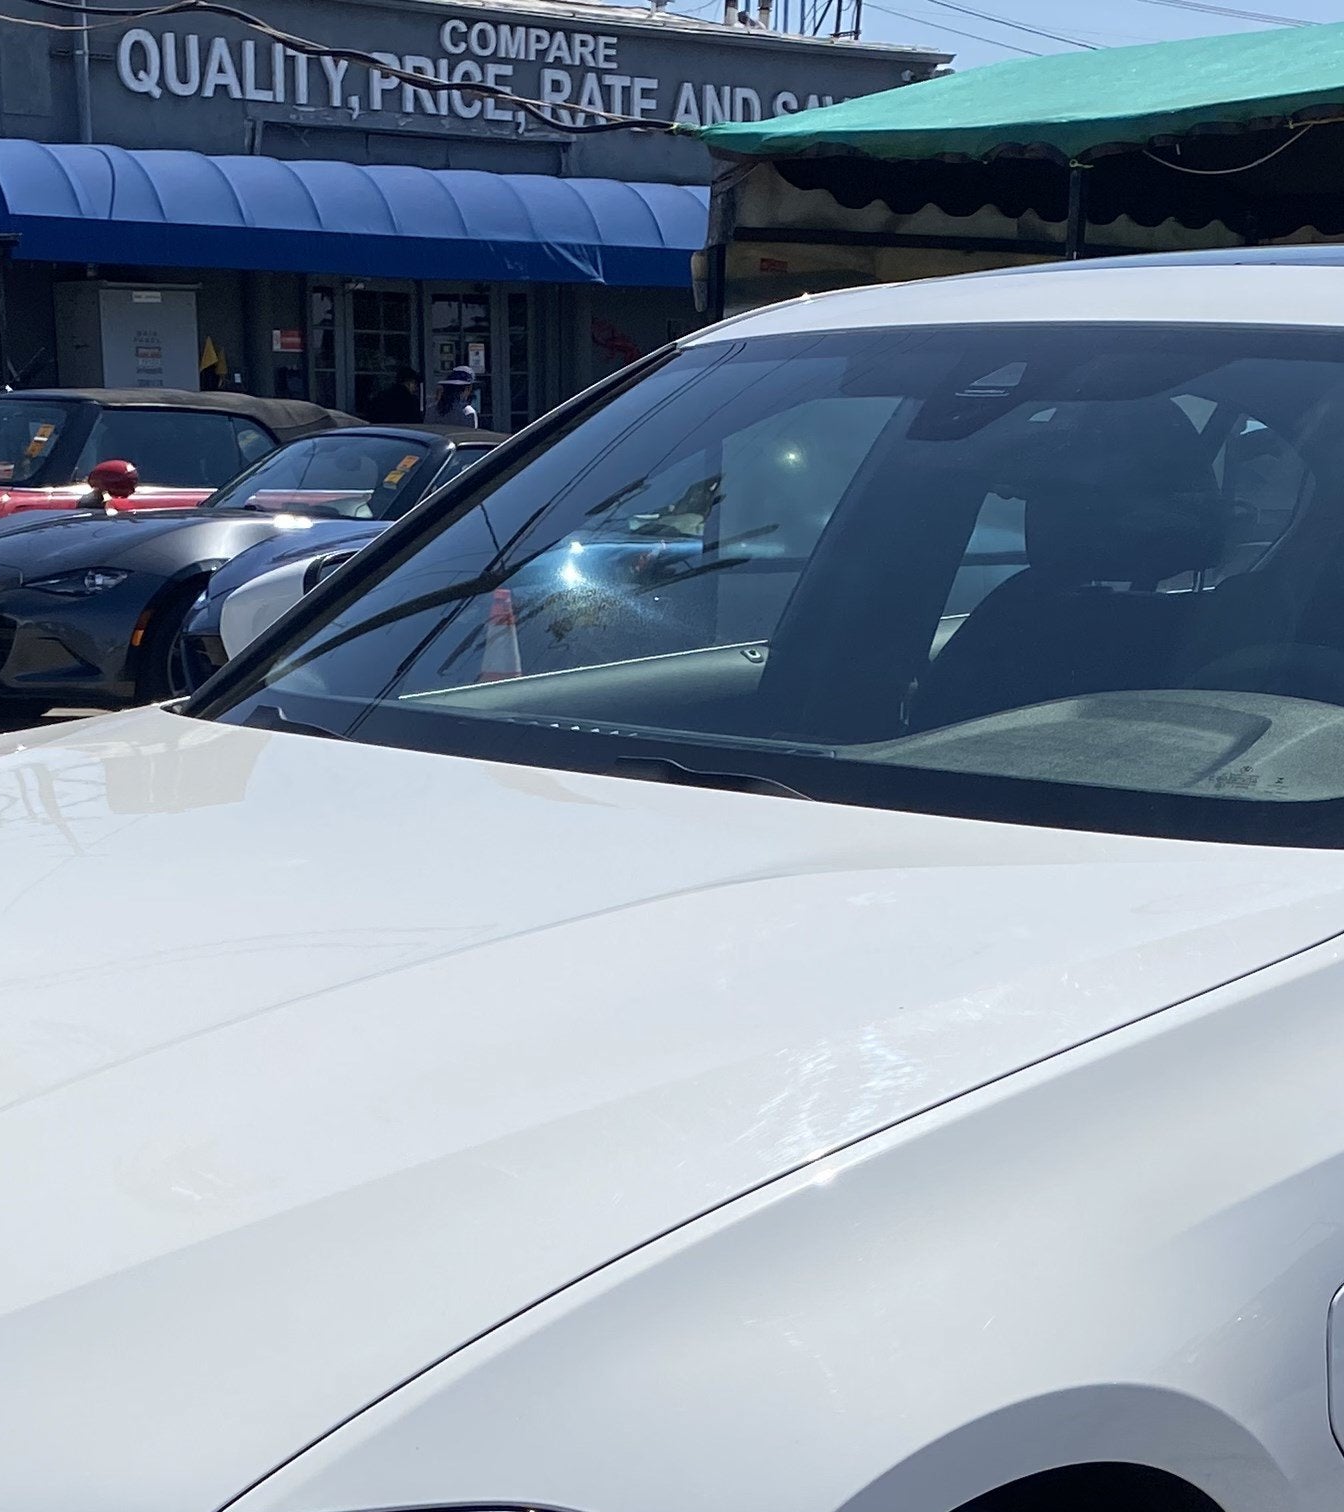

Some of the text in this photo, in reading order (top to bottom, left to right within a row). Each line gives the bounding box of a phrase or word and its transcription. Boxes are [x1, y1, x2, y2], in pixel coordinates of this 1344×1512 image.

[117, 28, 762, 133] QUALITY, PRICE, RATE AND
[440, 19, 618, 70] COMPARE
